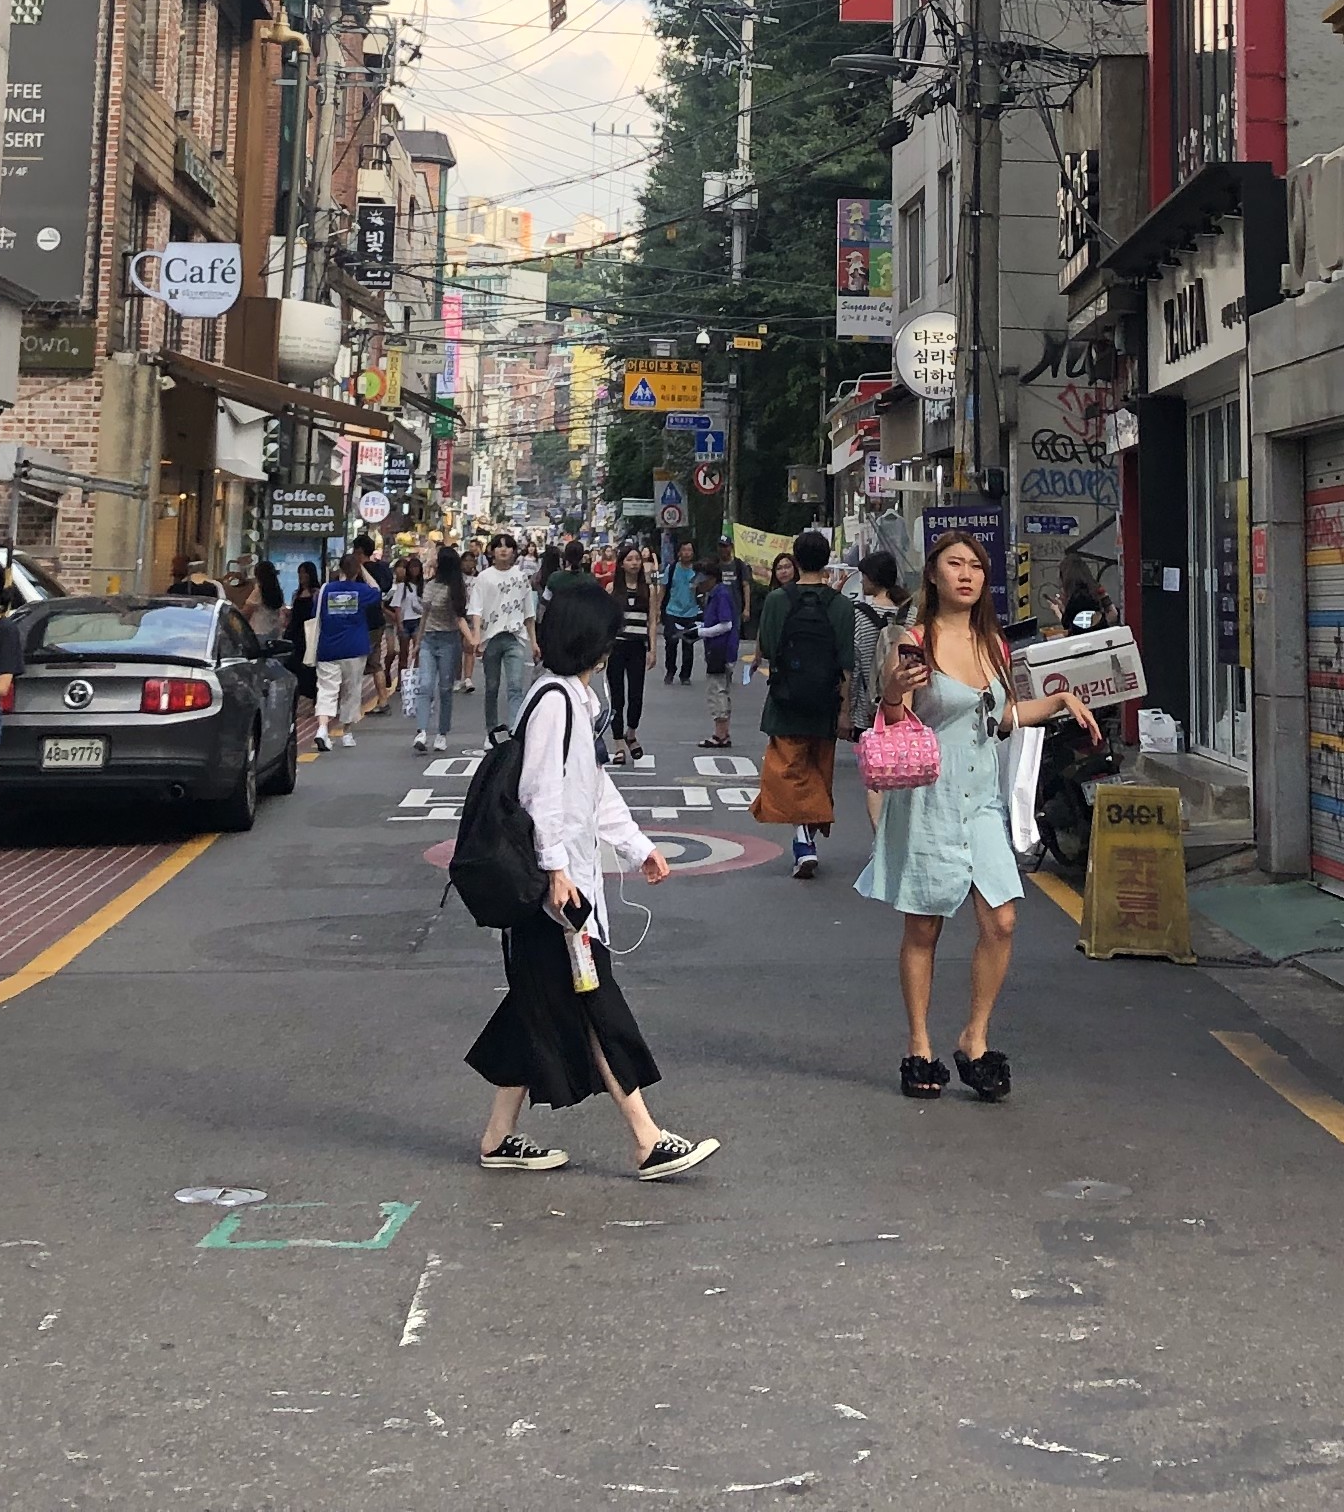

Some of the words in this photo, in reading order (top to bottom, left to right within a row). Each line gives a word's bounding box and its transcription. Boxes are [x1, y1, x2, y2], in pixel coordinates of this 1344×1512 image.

[164, 257, 237, 285] Café
[391, 459, 406, 468] DM
[272, 489, 326, 502] Coffee
[272, 504, 335, 517] Brunch
[271, 519, 335, 532] Dessert
